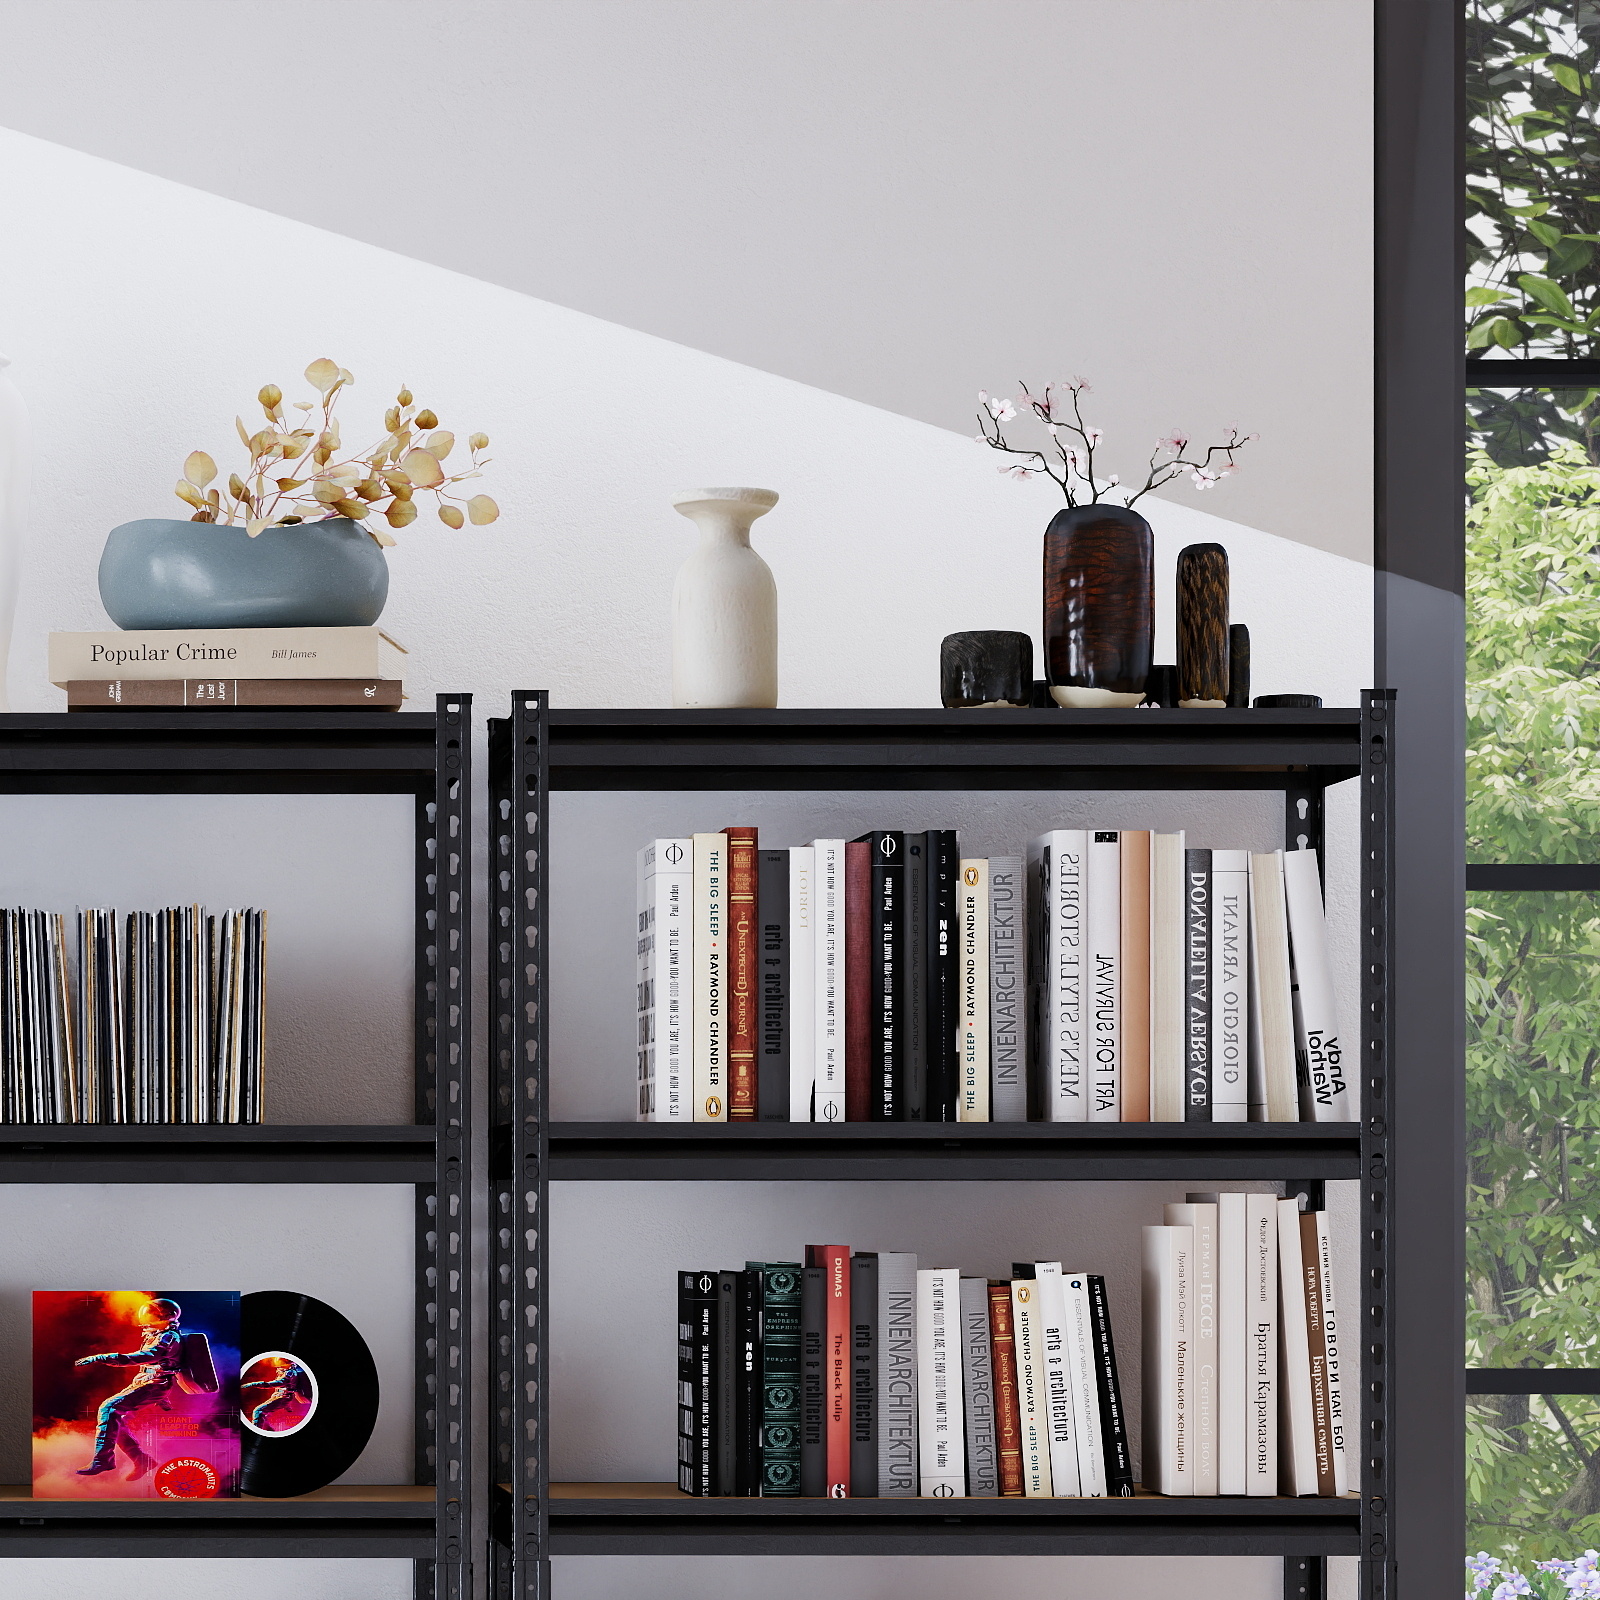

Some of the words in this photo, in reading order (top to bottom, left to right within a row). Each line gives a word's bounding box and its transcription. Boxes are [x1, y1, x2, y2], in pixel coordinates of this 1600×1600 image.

[91, 644, 169, 665] Popular
[176, 643, 237, 661] Crime
[272, 649, 287, 659] Bill
[288, 649, 317, 660] James
[196, 684, 204, 698] The
[710, 850, 719, 872] THE
[709, 877, 719, 898] BIG
[800, 869, 809, 929] LORIOT
[883, 877, 892, 895] Arden
[883, 897, 892, 911] Paul
[710, 903, 719, 936] SLEEP
[883, 921, 893, 931] BE.
[966, 896, 975, 955] CHANDLER
[765, 925, 783, 950] arts
[883, 933, 893, 941] TO
[883, 943, 892, 961] WANT
[940, 919, 948, 956] zen
[736, 921, 749, 990] UNEXPECTED
[709, 954, 719, 1017] RAYMOND
[883, 962, 893, 993] YOU
[966, 959, 975, 1016] RAYMOND
[994, 873, 1018, 1085] INNENARCHITEKTUR
[734, 990, 750, 1036] JOURNEY
[764, 974, 784, 1055] architecture
[883, 1011, 893, 1023] HOW
[883, 1025, 893, 1040] IT'S
[883, 1041, 893, 1054] ARE,
[966, 1032, 975, 1062] SLEEP
[709, 1021, 719, 1085] CHANDLER
[884, 1055, 892, 1072] YOU
[883, 1073, 893, 1088] GOOD
[966, 1067, 975, 1086] BIG
[883, 1089, 893, 1102] HOW
[966, 1091, 975, 1111] THE
[834, 1258, 842, 1298] DUMAS
[1177, 1251, 1186, 1278] Луиза
[1307, 1266, 1317, 1290] НОРА
[1178, 1280, 1186, 1300] Мэй
[1178, 1301, 1186, 1333] Олкотт
[1200, 1283, 1213, 1339] ГЕССЕ
[1308, 1291, 1320, 1331] РОБЕРТС
[834, 1334, 843, 1356] The
[1046, 1327, 1063, 1351] arts
[1254, 1323, 1270, 1376] Братья
[1325, 1310, 1339, 1382] ГОВОРИ
[833, 1359, 843, 1390] Black
[1177, 1341, 1187, 1410] Маленькие
[888, 1292, 912, 1490] INNENARCHITEKTUR
[1200, 1364, 1214, 1436] Степной
[1312, 1355, 1326, 1426] Бархатная
[1331, 1390, 1341, 1418] КАК
[832, 1393, 843, 1422] Tulip
[1049, 1370, 1071, 1442] architecture
[1176, 1412, 1185, 1472] женщины
[1254, 1381, 1271, 1474] Карамазовы
[1333, 1426, 1344, 1452] БОГ
[1201, 1442, 1210, 1477] волк
[1318, 1428, 1328, 1475] смерть
[161, 1463, 177, 1475] THE
[177, 1460, 216, 1490] ASTRONAUTS
